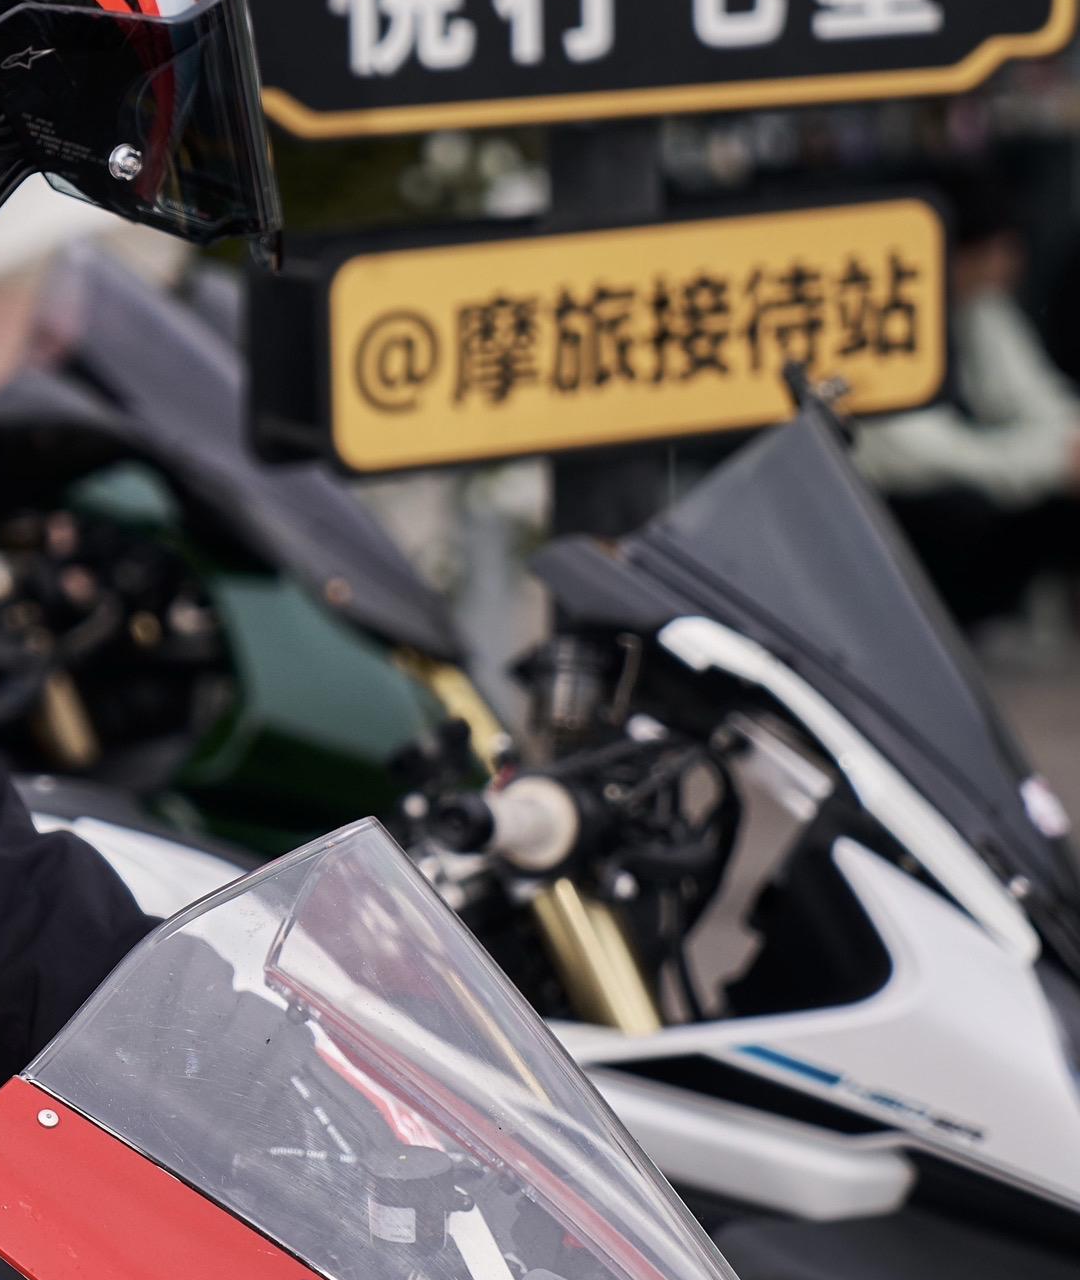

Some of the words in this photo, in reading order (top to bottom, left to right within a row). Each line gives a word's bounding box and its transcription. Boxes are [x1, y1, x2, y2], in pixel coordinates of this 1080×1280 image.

[353, 248, 922, 417] @摩旅接待站
